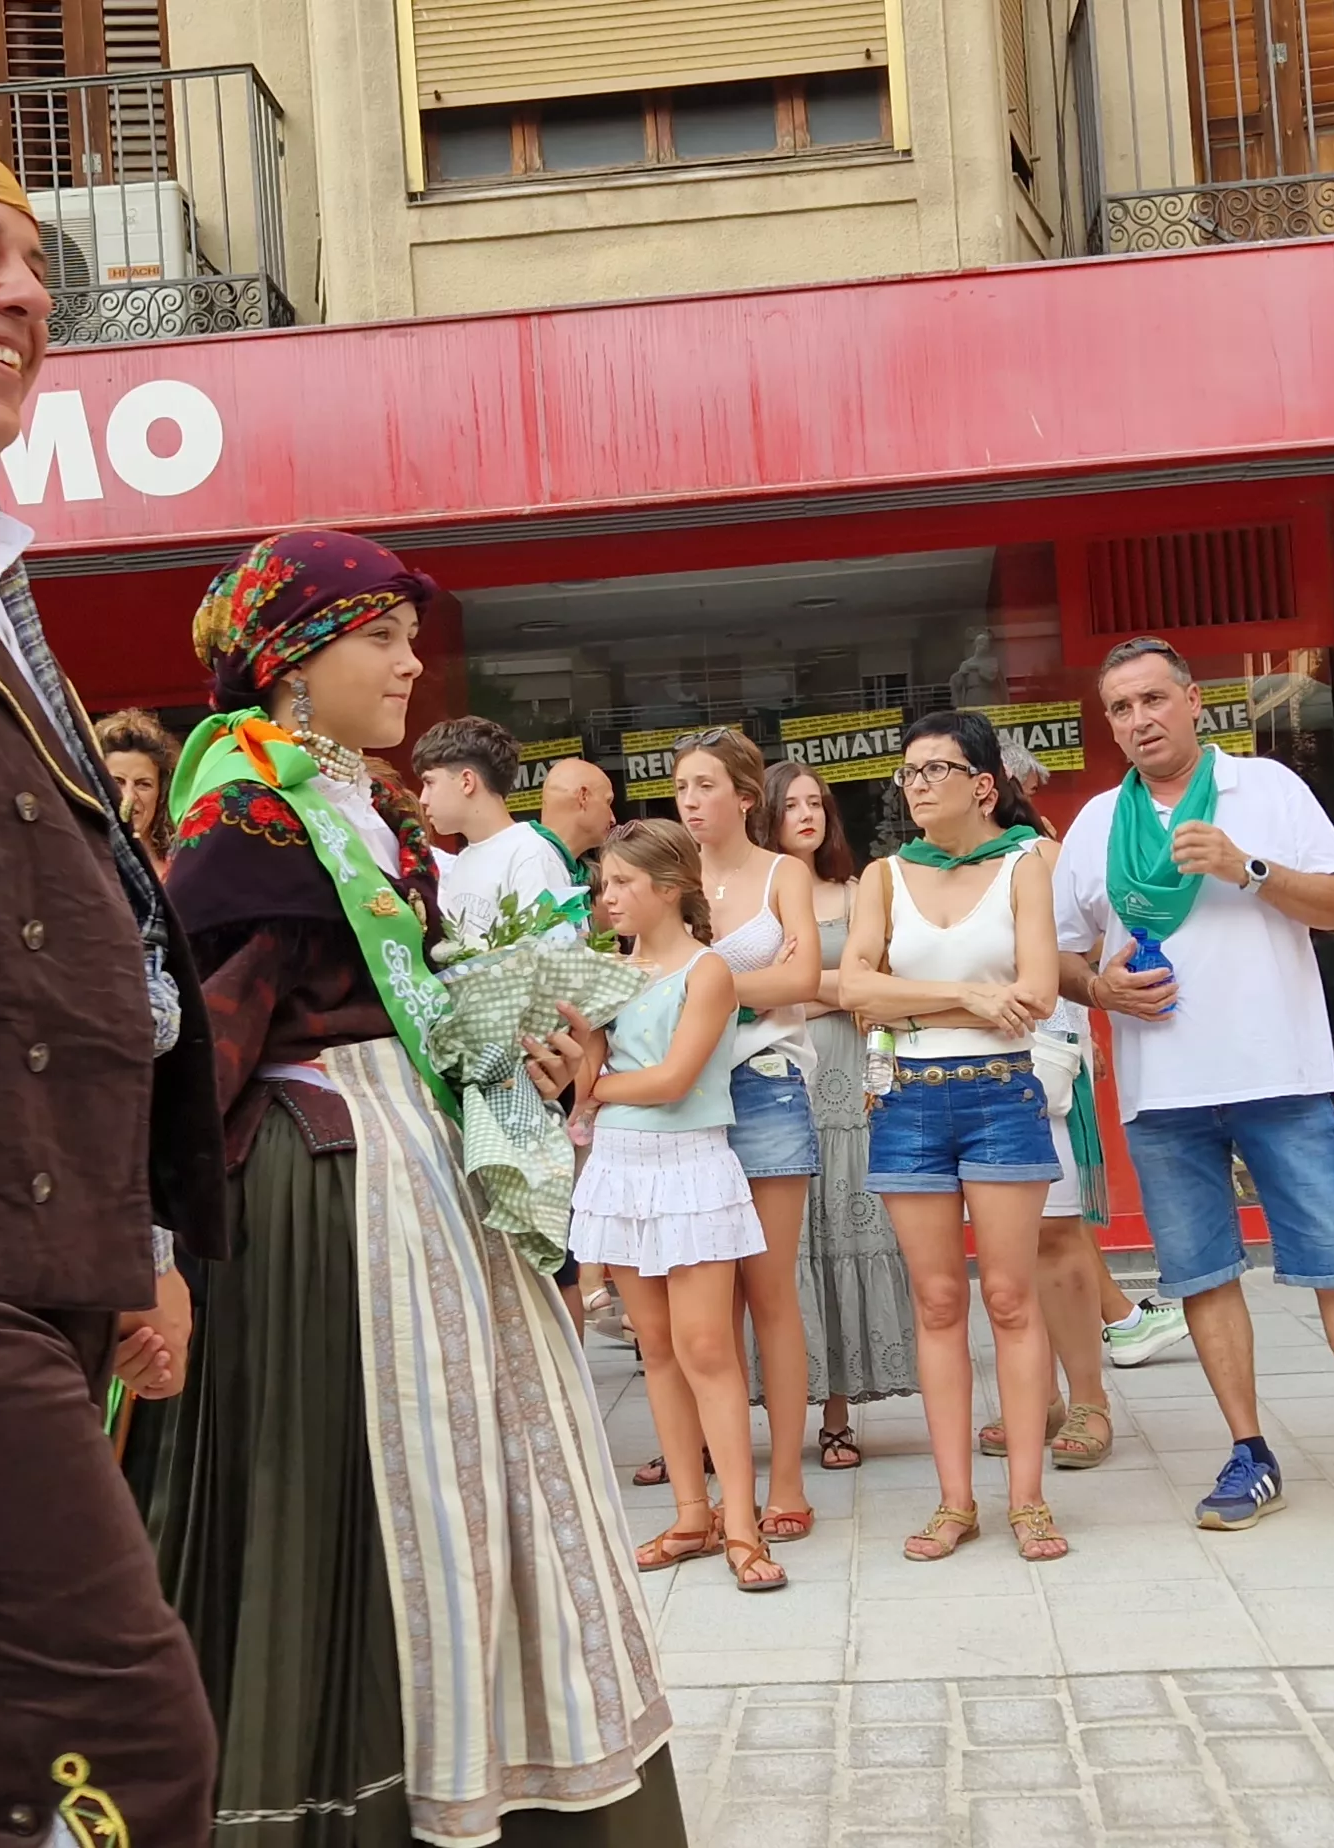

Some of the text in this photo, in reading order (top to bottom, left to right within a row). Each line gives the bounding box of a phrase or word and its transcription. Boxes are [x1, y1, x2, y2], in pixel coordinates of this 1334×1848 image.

[1196, 703, 1249, 733] ATE
[786, 727, 902, 764] REMATE
[998, 720, 1080, 749] MATE
